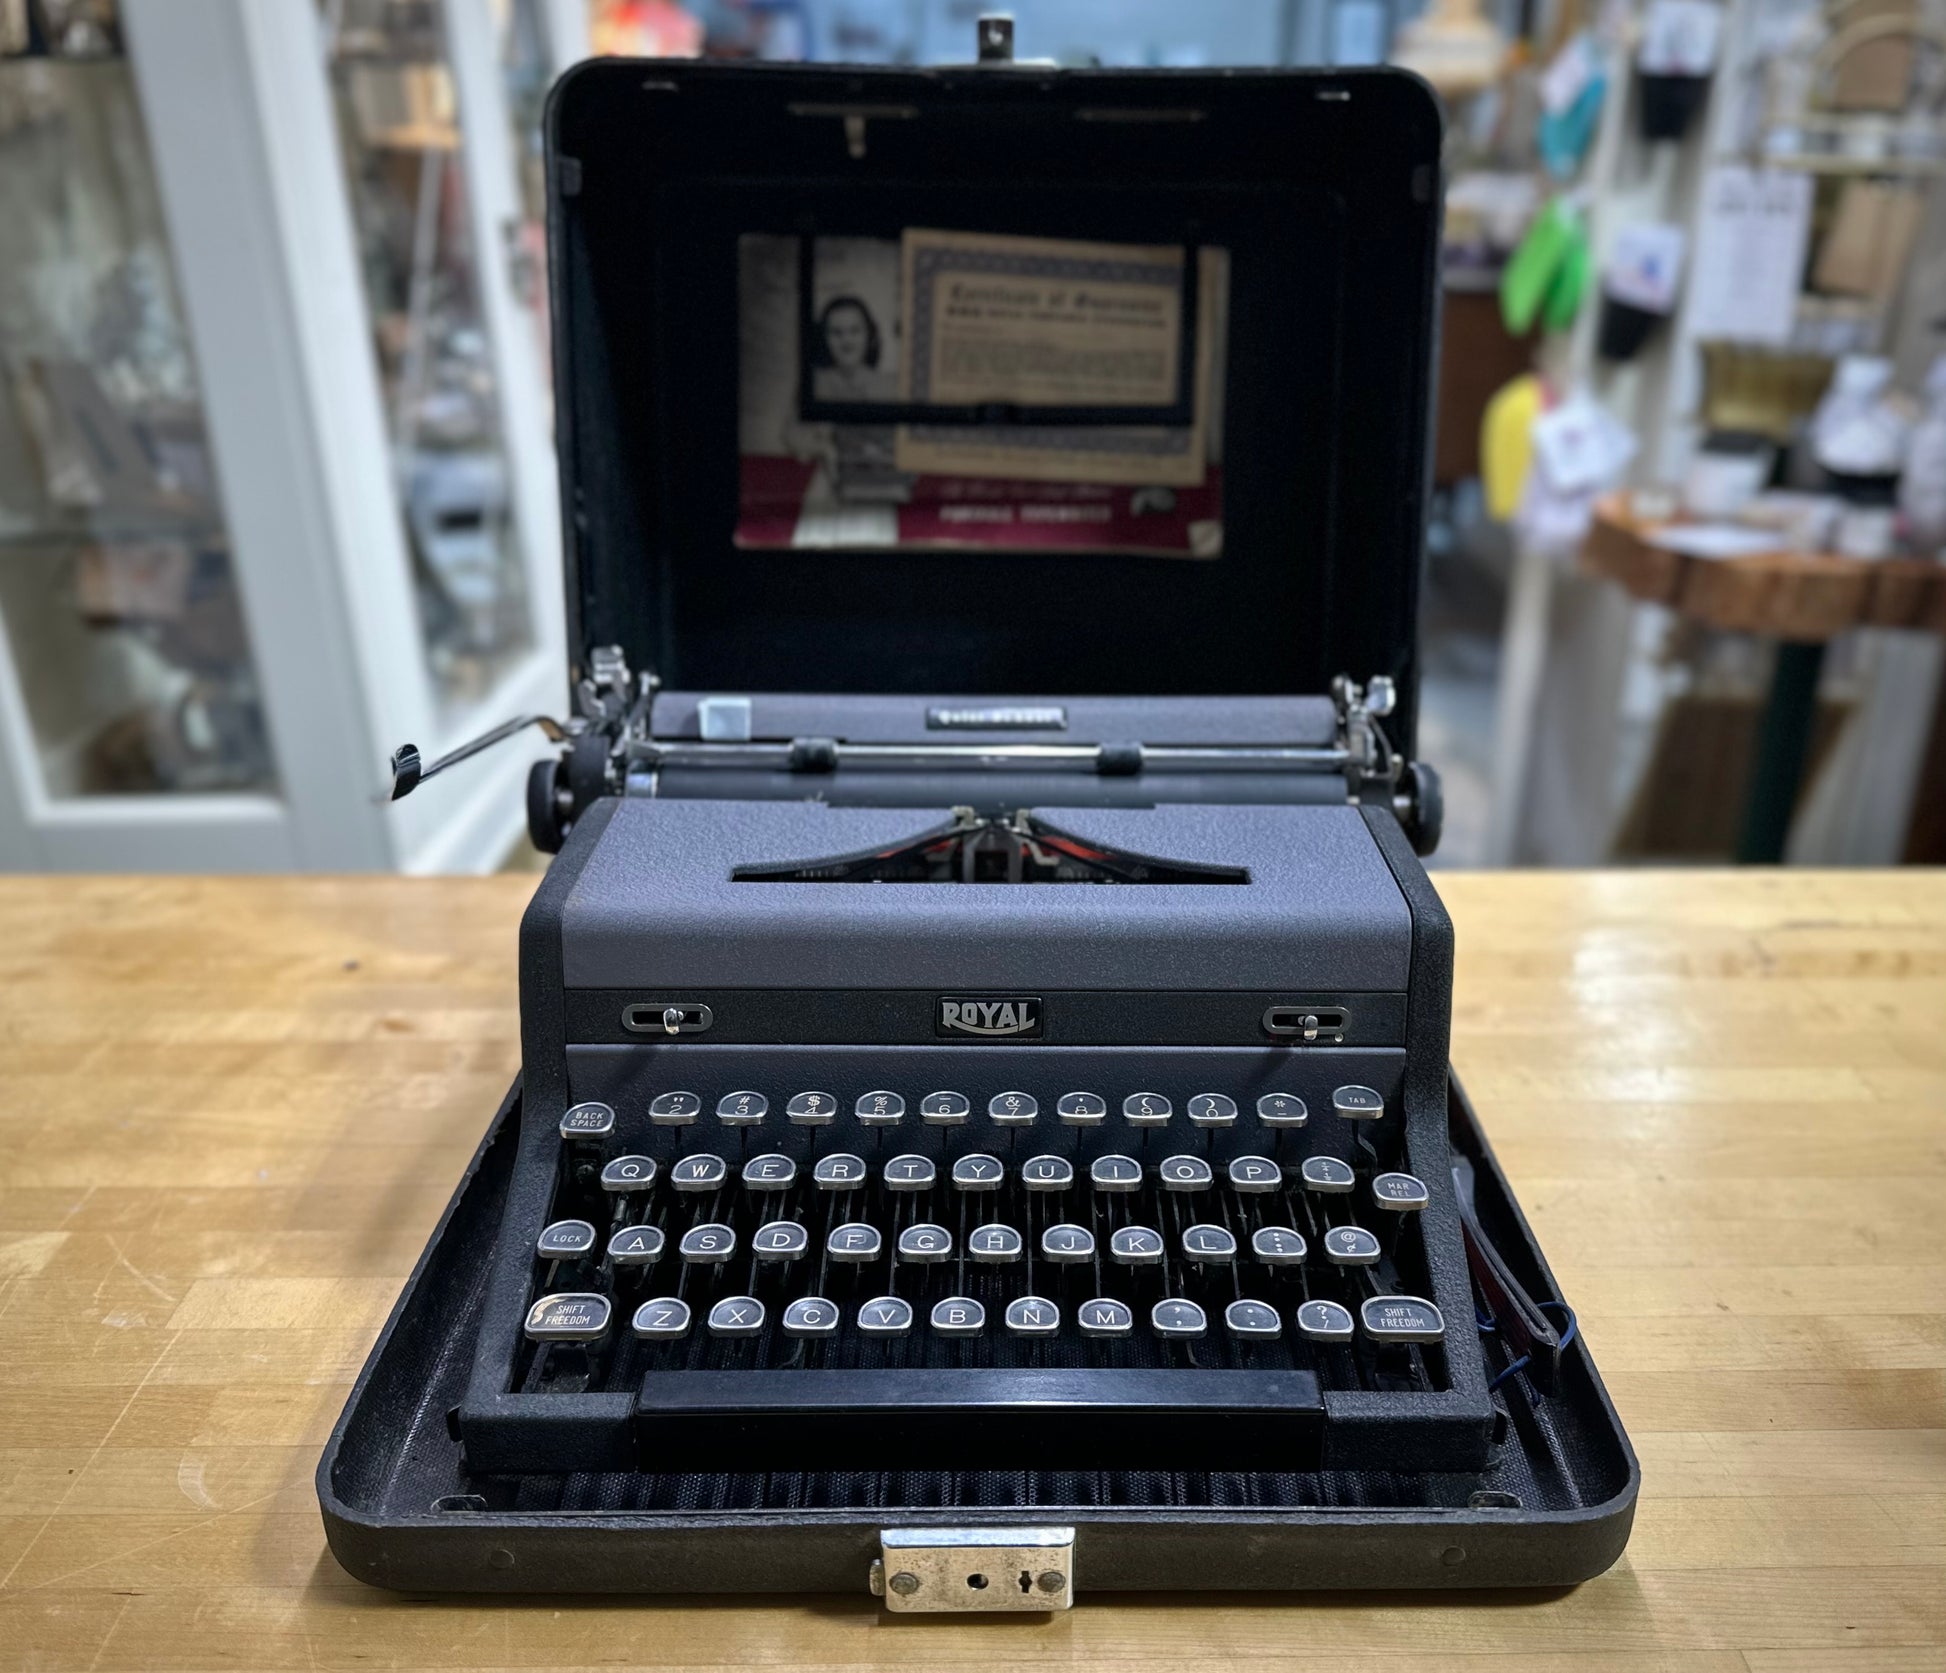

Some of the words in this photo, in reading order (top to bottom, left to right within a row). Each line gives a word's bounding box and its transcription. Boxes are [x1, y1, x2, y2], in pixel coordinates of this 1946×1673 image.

[942, 1002, 1035, 1035] ROYAL
[668, 1105, 682, 1114] 2
[734, 1106, 748, 1115] 3
[873, 1106, 886, 1115] 5
[938, 1104, 951, 1114] 6
[1008, 1107, 1019, 1116] 7
[1075, 1106, 1087, 1115] 8
[1140, 1107, 1153, 1116] 9
[570, 1119, 603, 1127] SPACE
[621, 1164, 640, 1178] Q
[692, 1164, 710, 1178] W
[761, 1164, 780, 1177] E
[831, 1164, 848, 1177] R
[903, 1164, 918, 1178] T
[971, 1164, 986, 1178] Y
[1038, 1165, 1055, 1178] U
[1176, 1165, 1195, 1179] O
[1246, 1166, 1262, 1179] P
[1387, 1182, 1409, 1190] MAR
[552, 1234, 582, 1243] LOCK
[627, 1236, 645, 1250] A
[699, 1235, 718, 1249] S
[771, 1233, 791, 1247] D
[845, 1234, 864, 1248] F
[917, 1235, 935, 1248] G
[986, 1236, 1003, 1249] H
[1061, 1236, 1075, 1250] J
[1199, 1236, 1216, 1249] L
[1340, 1231, 1356, 1243] @
[1128, 1237, 1146, 1251] K
[556, 1305, 586, 1314] SHIFT
[1384, 1308, 1412, 1317] SHIFT
[545, 1315, 591, 1325] FREEDOM
[653, 1310, 673, 1326] Z
[728, 1309, 748, 1324] X
[803, 1309, 821, 1324] C
[878, 1309, 896, 1324] V
[949, 1309, 966, 1324] B
[1023, 1309, 1041, 1324] N
[1096, 1310, 1115, 1324] M
[1380, 1318, 1425, 1327] FREEDOM
